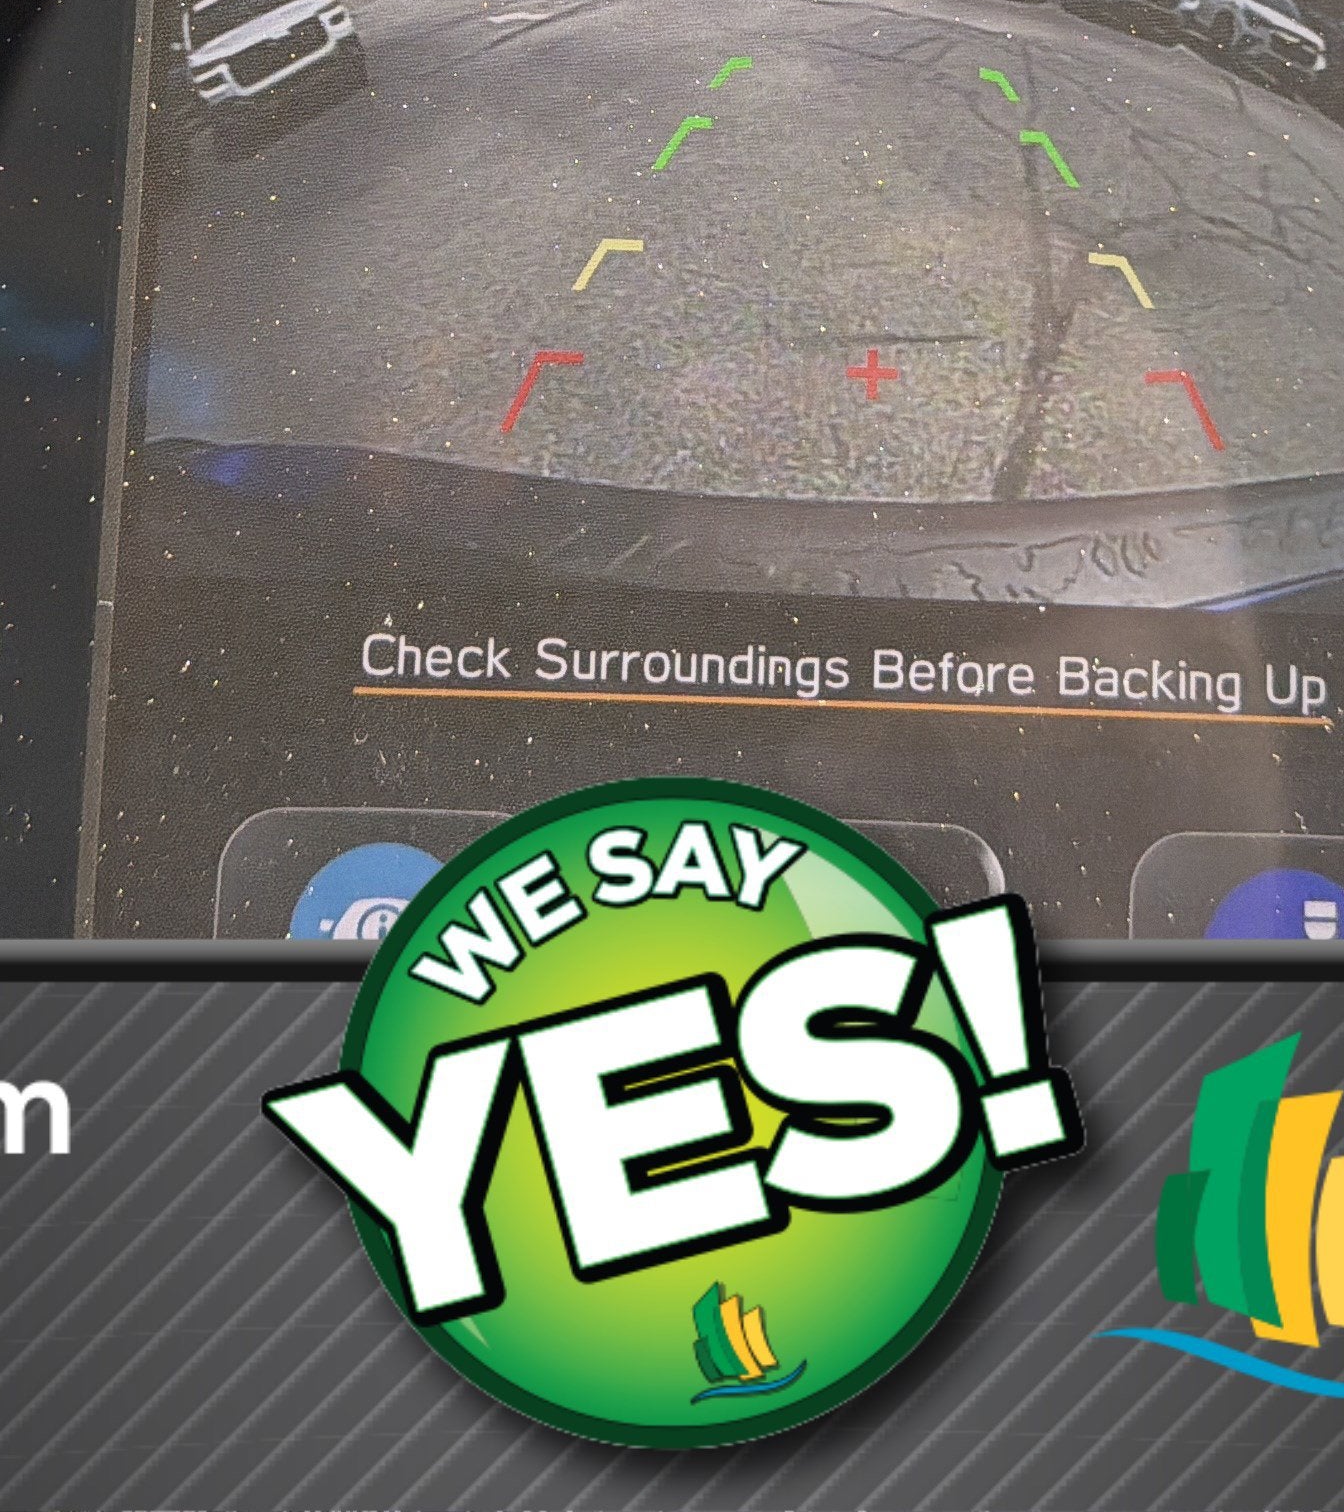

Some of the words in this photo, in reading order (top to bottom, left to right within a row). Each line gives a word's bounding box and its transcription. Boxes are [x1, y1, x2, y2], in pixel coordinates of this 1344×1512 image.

[361, 634, 513, 681] Check
[535, 638, 852, 700] Surroundings
[872, 649, 1037, 697] Before
[1057, 656, 1243, 714] Backing
[1263, 664, 1329, 714] Up
